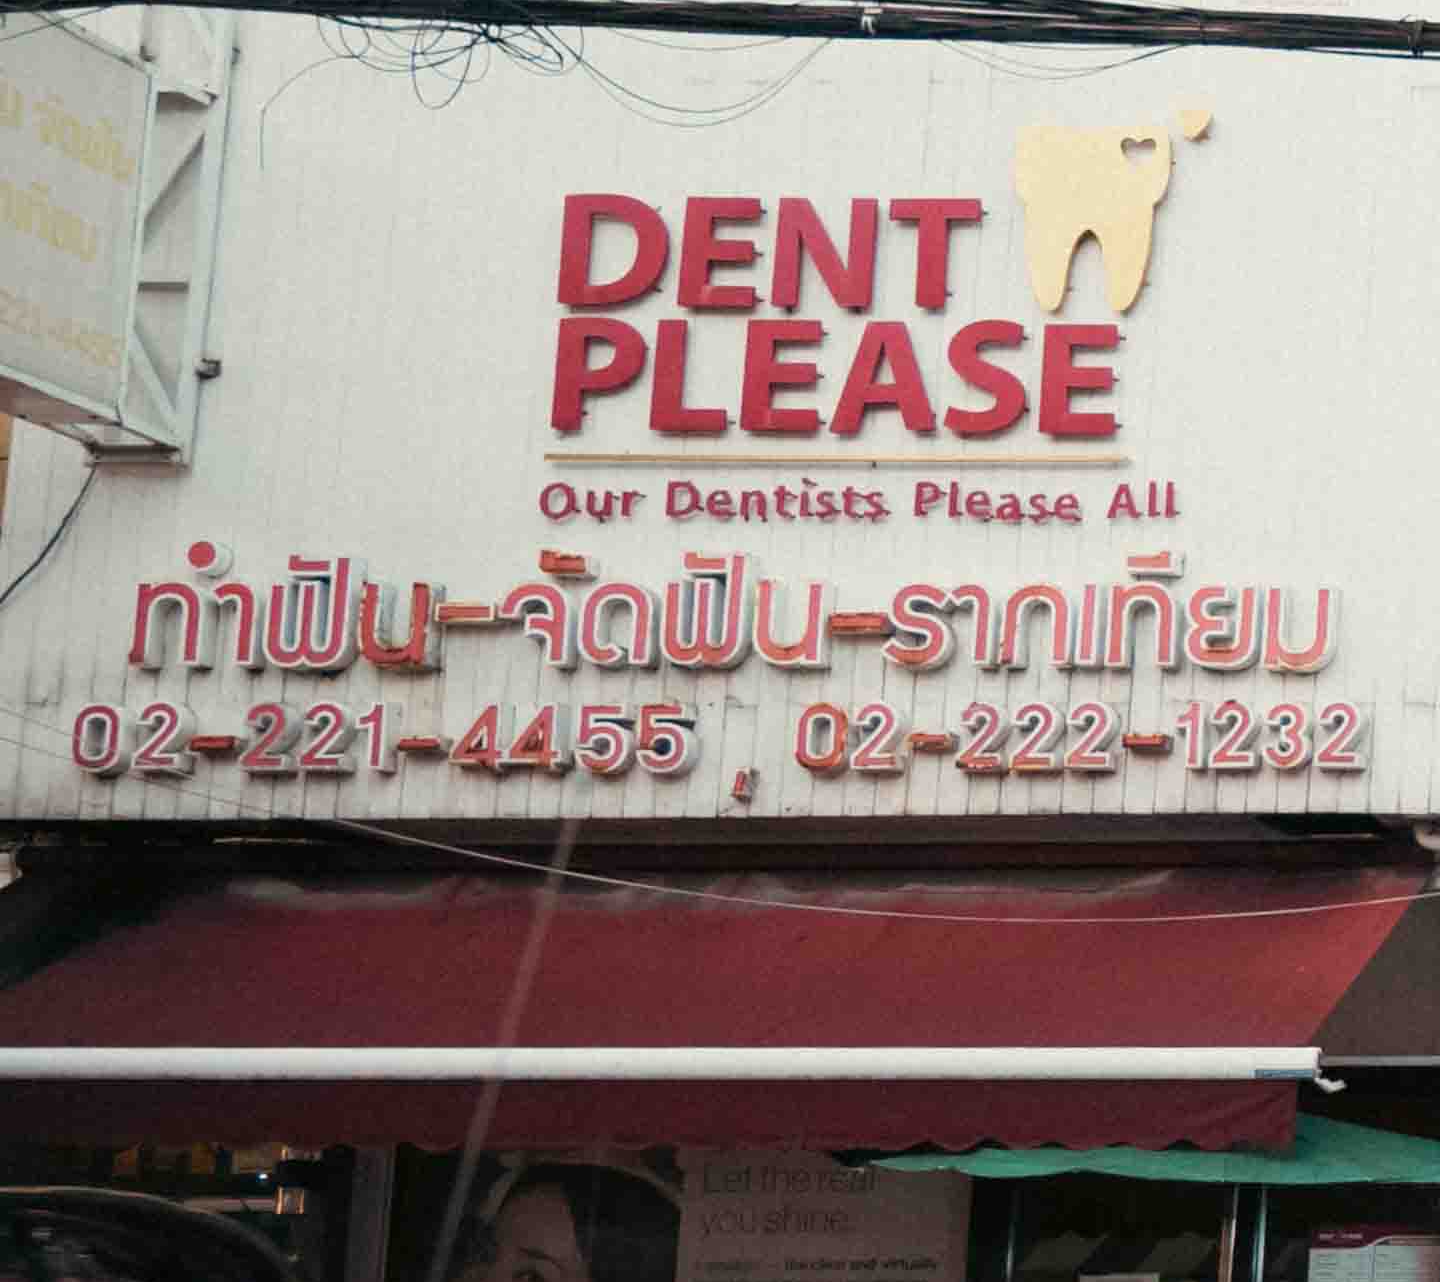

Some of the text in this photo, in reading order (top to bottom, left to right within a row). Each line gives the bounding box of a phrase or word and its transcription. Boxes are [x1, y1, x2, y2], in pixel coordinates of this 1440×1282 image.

[559, 194, 982, 309] DENT
[551, 318, 1120, 435] PLEASE
[538, 478, 1181, 522] Our Dentists Please All
[73, 701, 1366, 776] 02-221-4455 02-222-1232
[704, 1166, 751, 1192] Let
[701, 1212, 756, 1236] you
